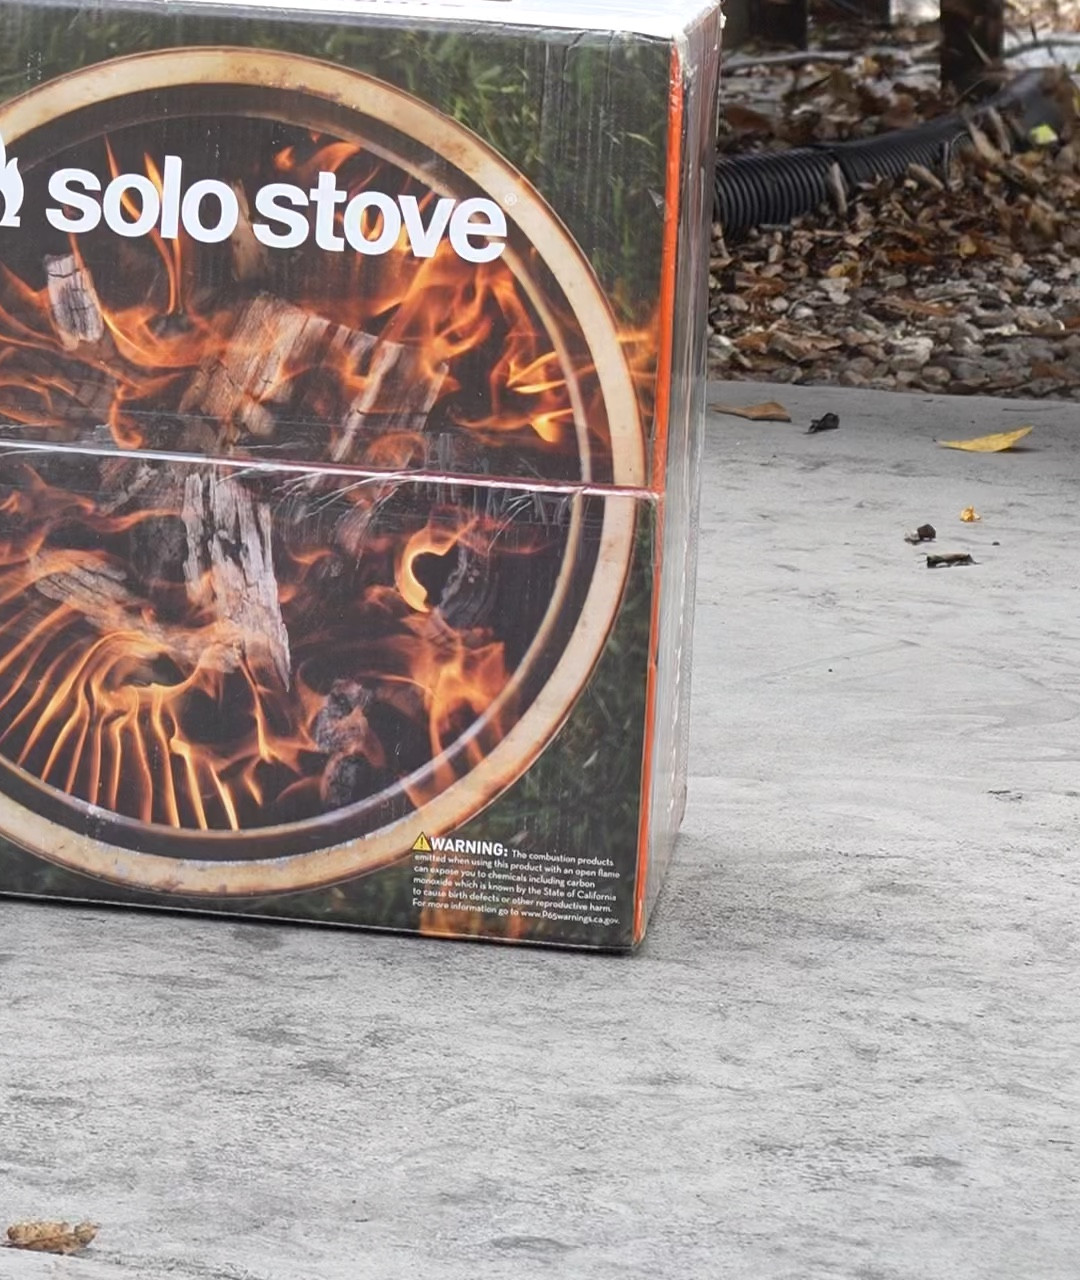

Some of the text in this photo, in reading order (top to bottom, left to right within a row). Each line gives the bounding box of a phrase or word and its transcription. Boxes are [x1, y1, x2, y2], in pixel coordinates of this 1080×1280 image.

[45, 155, 508, 263] solo stove
[430, 837, 615, 867] WARNING: The combustion products
[414, 854, 446, 863] emitted
[448, 855, 470, 865] when
[471, 858, 492, 869] using
[494, 858, 509, 869] this
[510, 862, 542, 873] product
[544, 865, 562, 874] with
[575, 869, 596, 878] open
[598, 867, 620, 879] flame
[430, 868, 459, 877] expose
[461, 869, 476, 878] you
[488, 870, 527, 882] chemicals
[529, 874, 565, 888] including
[566, 878, 595, 888] carbon
[413, 877, 453, 886] monoxide
[454, 879, 478, 889] which
[488, 881, 515, 892] known
[516, 884, 527, 896] by
[528, 886, 542, 895] the
[543, 887, 565, 898] State
[566, 888, 575, 898] of
[577, 891, 617, 902] California
[413, 887, 422, 896] to
[448, 889, 468, 900] birth
[470, 892, 500, 903] defects
[512, 896, 534, 906] other
[536, 900, 588, 911] reproductive
[413, 897, 426, 907] For
[428, 901, 449, 909] more
[451, 901, 498, 914] information
[498, 908, 509, 917] go
[510, 907, 519, 916] to
